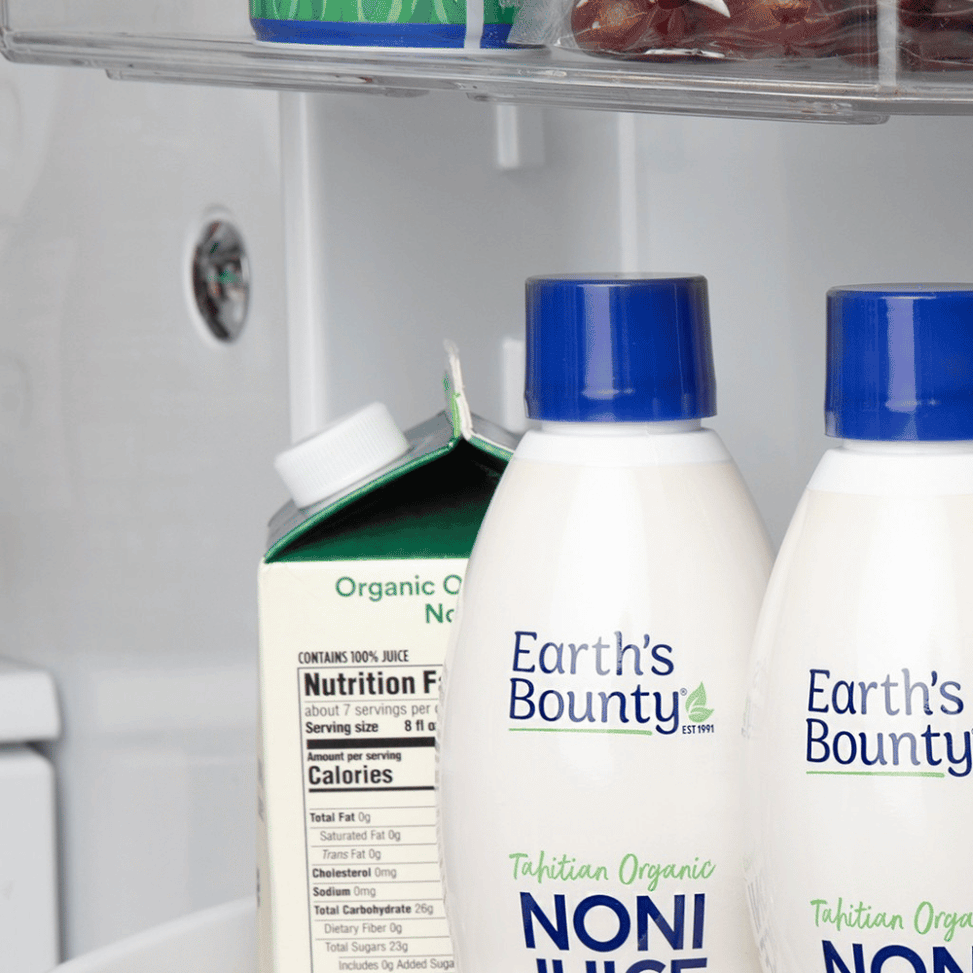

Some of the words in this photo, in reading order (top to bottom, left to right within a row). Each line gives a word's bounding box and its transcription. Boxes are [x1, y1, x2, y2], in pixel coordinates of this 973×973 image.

[336, 575, 435, 602] Organic
[298, 650, 348, 664] CONTAINS
[350, 650, 378, 664] 100%
[382, 650, 409, 662] JUICE
[512, 631, 675, 676] Earth's
[304, 672, 416, 696] Nutrition
[808, 668, 964, 716] Earth's
[305, 704, 340, 717] about
[344, 704, 350, 716] 7
[355, 703, 407, 718] servings
[411, 704, 430, 719] per
[306, 721, 352, 736] Serving
[354, 720, 379, 734] size
[404, 720, 412, 732] 8
[416, 720, 425, 732] fl
[697, 724, 714, 734] 1991
[307, 752, 344, 762] Amount
[347, 752, 362, 764] per
[366, 750, 402, 763] serving
[308, 766, 394, 785] Calories
[310, 812, 335, 823] Total
[338, 812, 356, 823] Fat
[358, 812, 371, 824] 0g
[320, 831, 368, 842] Saturated
[371, 830, 385, 841] Fat
[388, 830, 402, 842] 0g
[322, 849, 349, 860] Trans
[351, 849, 366, 860] Fat
[368, 849, 382, 861] 0g
[312, 868, 372, 878] Cholesterol
[374, 867, 397, 880] 0mg
[508, 850, 608, 884] Tahitian
[618, 854, 716, 892] Organic
[313, 886, 351, 896] Sodium
[354, 886, 376, 898] 0mg
[314, 904, 339, 915] Total
[342, 904, 412, 917] Carbohydrate
[414, 904, 434, 916] 26g
[810, 897, 904, 931] Tahitian
[520, 891, 706, 952] NONI
[324, 923, 358, 936] Dietary
[362, 923, 386, 934] Fiber
[390, 922, 402, 935] 0g
[325, 942, 348, 952] Total
[352, 942, 386, 954] Sugars
[389, 941, 408, 953] 23g
[339, 960, 379, 971] Includes
[382, 960, 394, 972] 0g
[396, 960, 428, 970] Added
